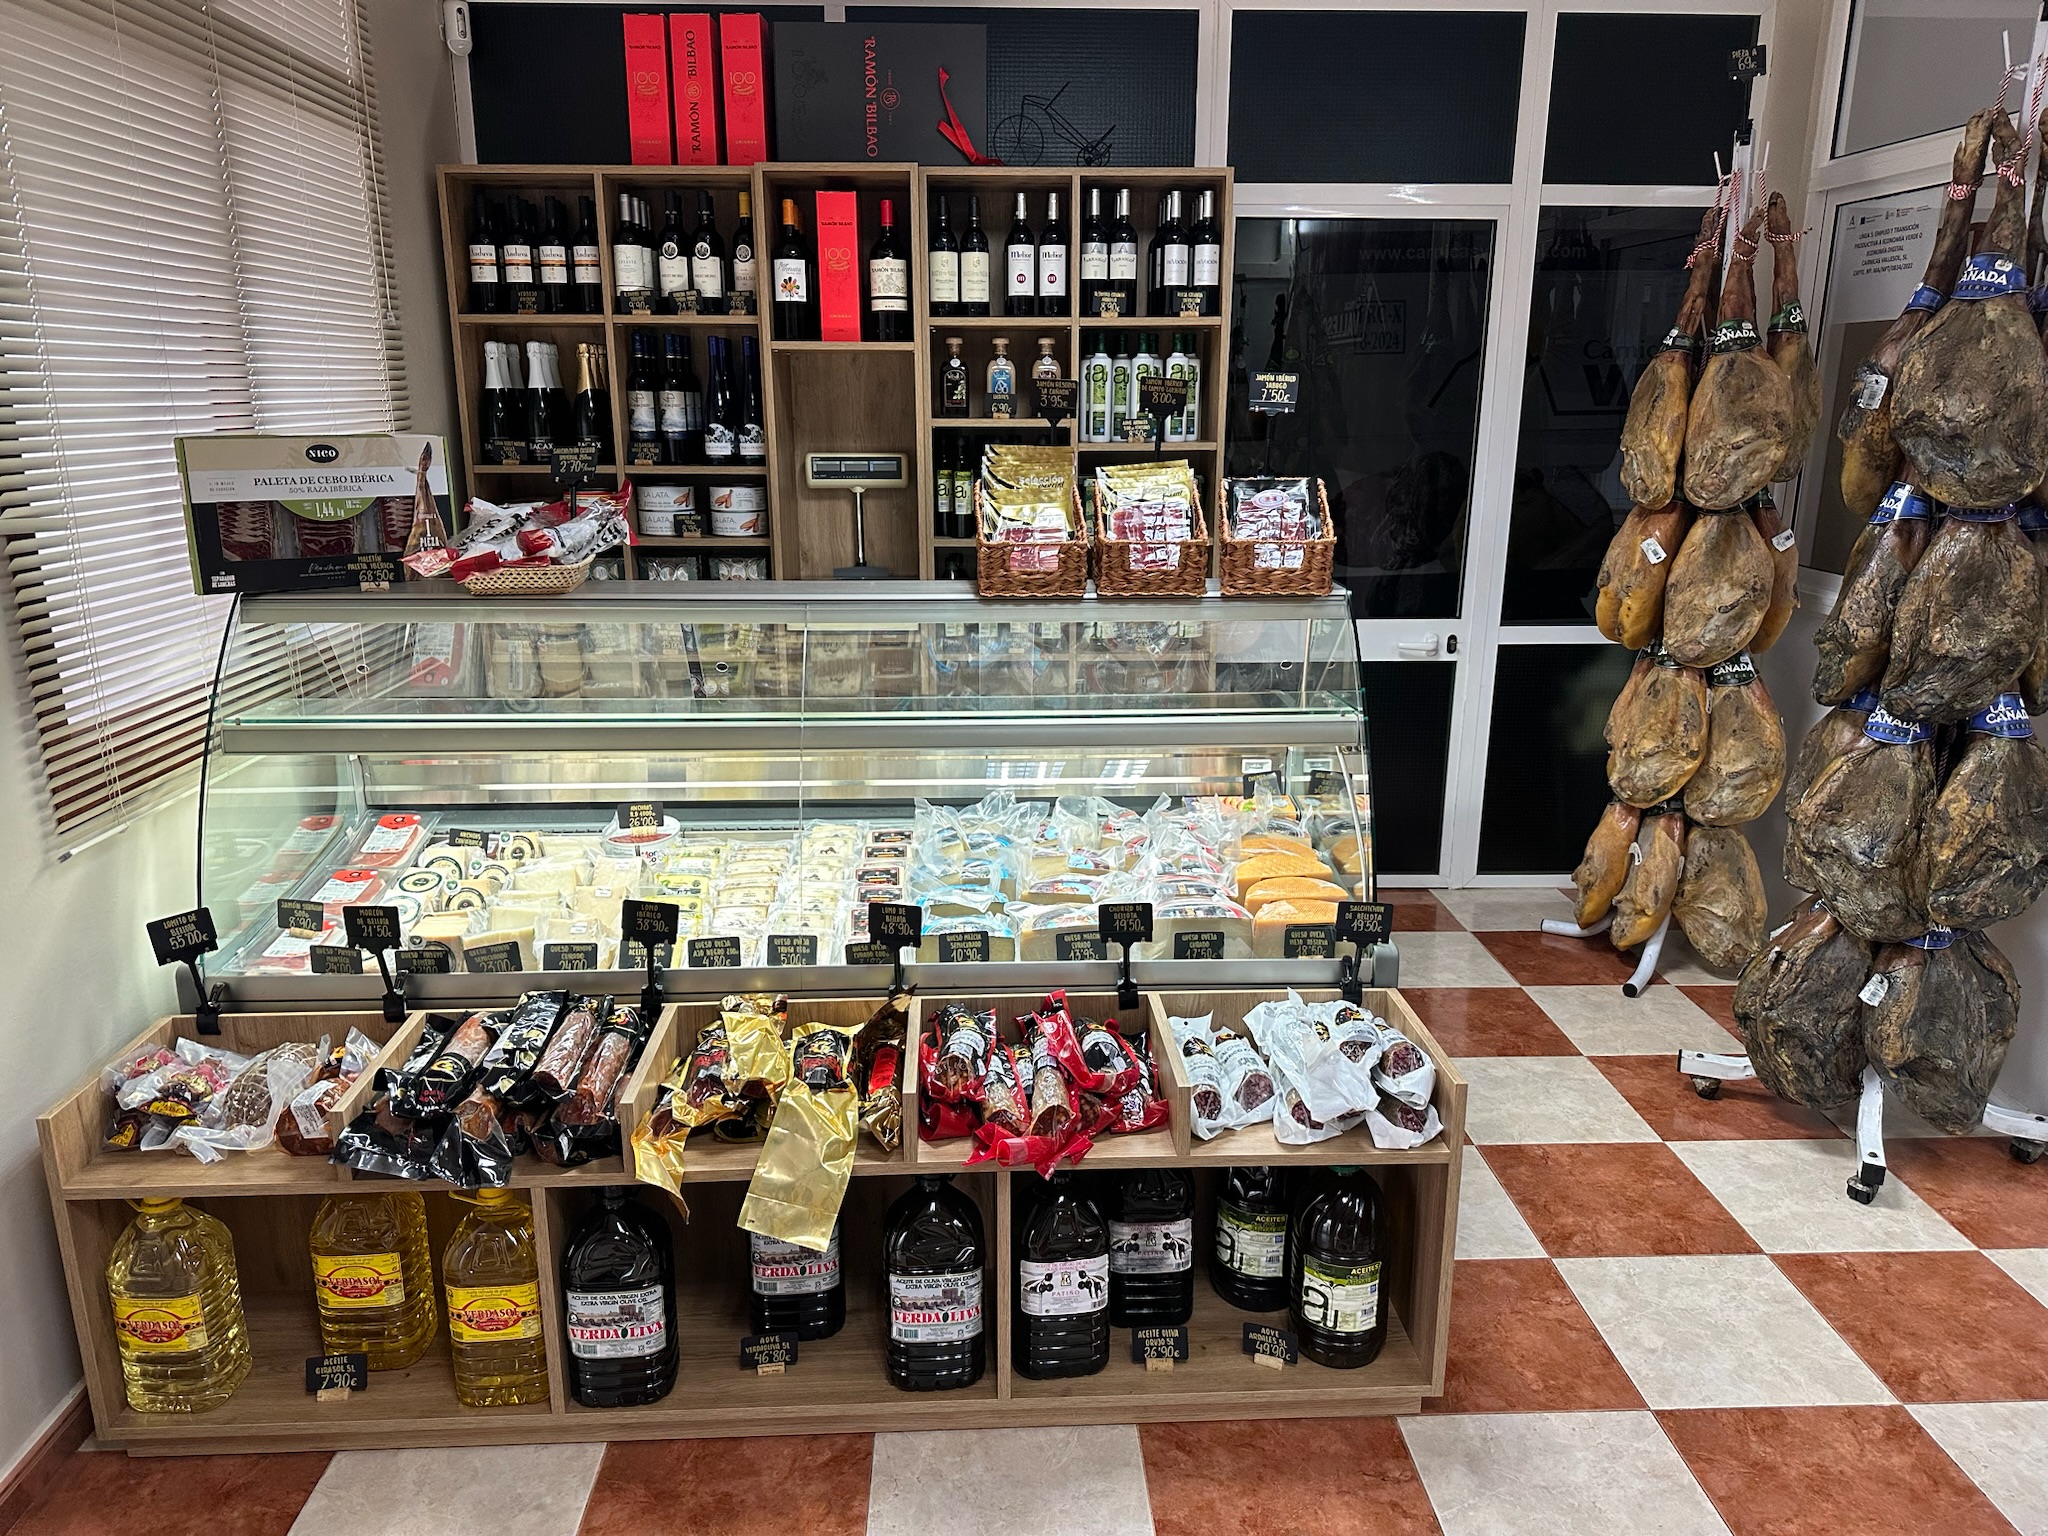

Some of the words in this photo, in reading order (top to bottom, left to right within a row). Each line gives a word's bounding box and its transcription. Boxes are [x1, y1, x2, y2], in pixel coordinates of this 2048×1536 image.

[686, 30, 696, 80] BILBAO
[1731, 49, 1749, 58] PIEZA
[1752, 48, 1757, 56] A
[864, 36, 877, 99] RAMÓN
[1738, 56, 1758, 70] 69€
[632, 71, 660, 84] 100
[730, 71, 756, 84] 100
[690, 101, 701, 154] RAMÓN
[865, 102, 878, 158] BILBAO
[824, 248, 851, 260] 100
[1146, 378, 1162, 386] JAMÓN
[1255, 373, 1274, 382] JAMÓN
[1276, 374, 1296, 382] IBÉRICO
[1036, 380, 1054, 388] JAMÓN
[1152, 392, 1176, 404] 8'00€
[1261, 389, 1290, 402] 7'50€
[1040, 395, 1068, 408] 3'95€
[991, 403, 1012, 413] 6'90€
[308, 449, 336, 458] NICO
[254, 477, 299, 486] PALETA
[300, 476, 314, 485] DE
[317, 475, 348, 484] CEBO
[350, 473, 395, 483] IBÉRICA
[1019, 476, 1064, 484] Selección
[330, 484, 363, 493] IBÉRICA
[315, 502, 334, 518] 1,44
[419, 537, 439, 547] PIEZA
[359, 570, 395, 581] 68'50€
[629, 817, 659, 826] 26'00€
[281, 902, 300, 910] JAMÓN
[881, 907, 897, 915] LOMO
[1109, 905, 1134, 913] CHORIZO
[359, 908, 384, 917] MORCÓN
[636, 911, 662, 919] IBÉRICO
[1356, 913, 1382, 921] BELLOTA
[163, 916, 187, 929] LOMITO
[187, 913, 197, 922] DE
[288, 917, 317, 930] 8'90€
[636, 918, 670, 933] 38'90€
[1113, 918, 1145, 932] 19'50€
[1351, 920, 1383, 933] 19'50€
[362, 925, 392, 937] 21'50€
[881, 923, 915, 935] 48'90€
[169, 930, 209, 950] 55'00€
[774, 938, 792, 946] QUESO
[946, 934, 962, 942] QUESO
[1200, 933, 1217, 941] OVEJA
[695, 940, 712, 948] QUESO
[950, 941, 982, 949] SEMICURADO
[951, 949, 982, 961] 10'90€
[1069, 949, 1100, 960] 13'95€
[1296, 945, 1327, 956] 18'50€
[702, 955, 731, 966] 4'80€
[780, 954, 807, 965] 5'00€
[479, 960, 517, 972] 23'00€
[1256, 1215, 1286, 1223] ACEITES
[1351, 1264, 1379, 1275] ACEITES
[329, 1276, 381, 1286] VERDASOL
[640, 1288, 657, 1298] EXTRA
[1052, 1289, 1080, 1297] PATIÑO
[464, 1308, 518, 1319] VERDASOL
[128, 1320, 180, 1330] VERDASOL
[1138, 1329, 1159, 1338] ACEITE
[1162, 1328, 1179, 1338] OLIVA
[1261, 1327, 1280, 1337] AOVE
[760, 1335, 780, 1343] AOVE
[1248, 1331, 1278, 1345] ARDALES
[1145, 1346, 1180, 1358] 26'90€
[1254, 1340, 1291, 1361] 49'90€
[323, 1357, 348, 1365] ACEITE
[754, 1350, 791, 1364] 46'80€
[315, 1364, 346, 1374] GIRASOL
[321, 1373, 357, 1389] 7'90€
